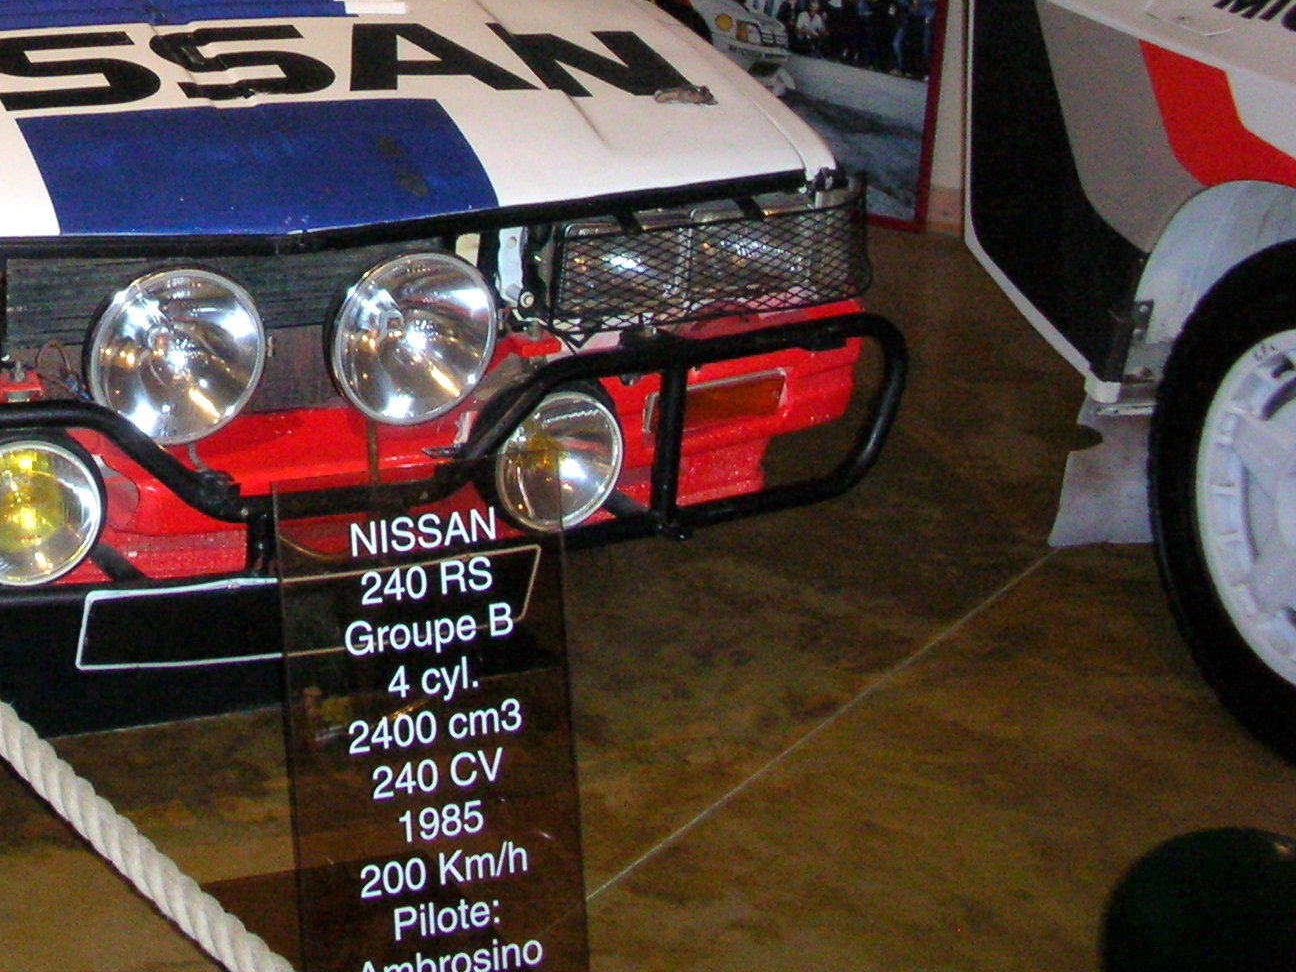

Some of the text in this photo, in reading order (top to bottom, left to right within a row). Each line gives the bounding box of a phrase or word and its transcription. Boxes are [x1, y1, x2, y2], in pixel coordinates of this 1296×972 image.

[349, 506, 497, 558] NISSAN
[360, 555, 494, 606] 240 RS
[344, 601, 514, 657] Groupe B
[388, 656, 480, 702] 4 cyl.
[348, 698, 523, 756] 2400 cm3
[372, 747, 504, 801] 240 CV
[399, 799, 484, 845] 1985
[359, 840, 528, 900] 200 Km/h
[393, 899, 501, 942] Pilote:
